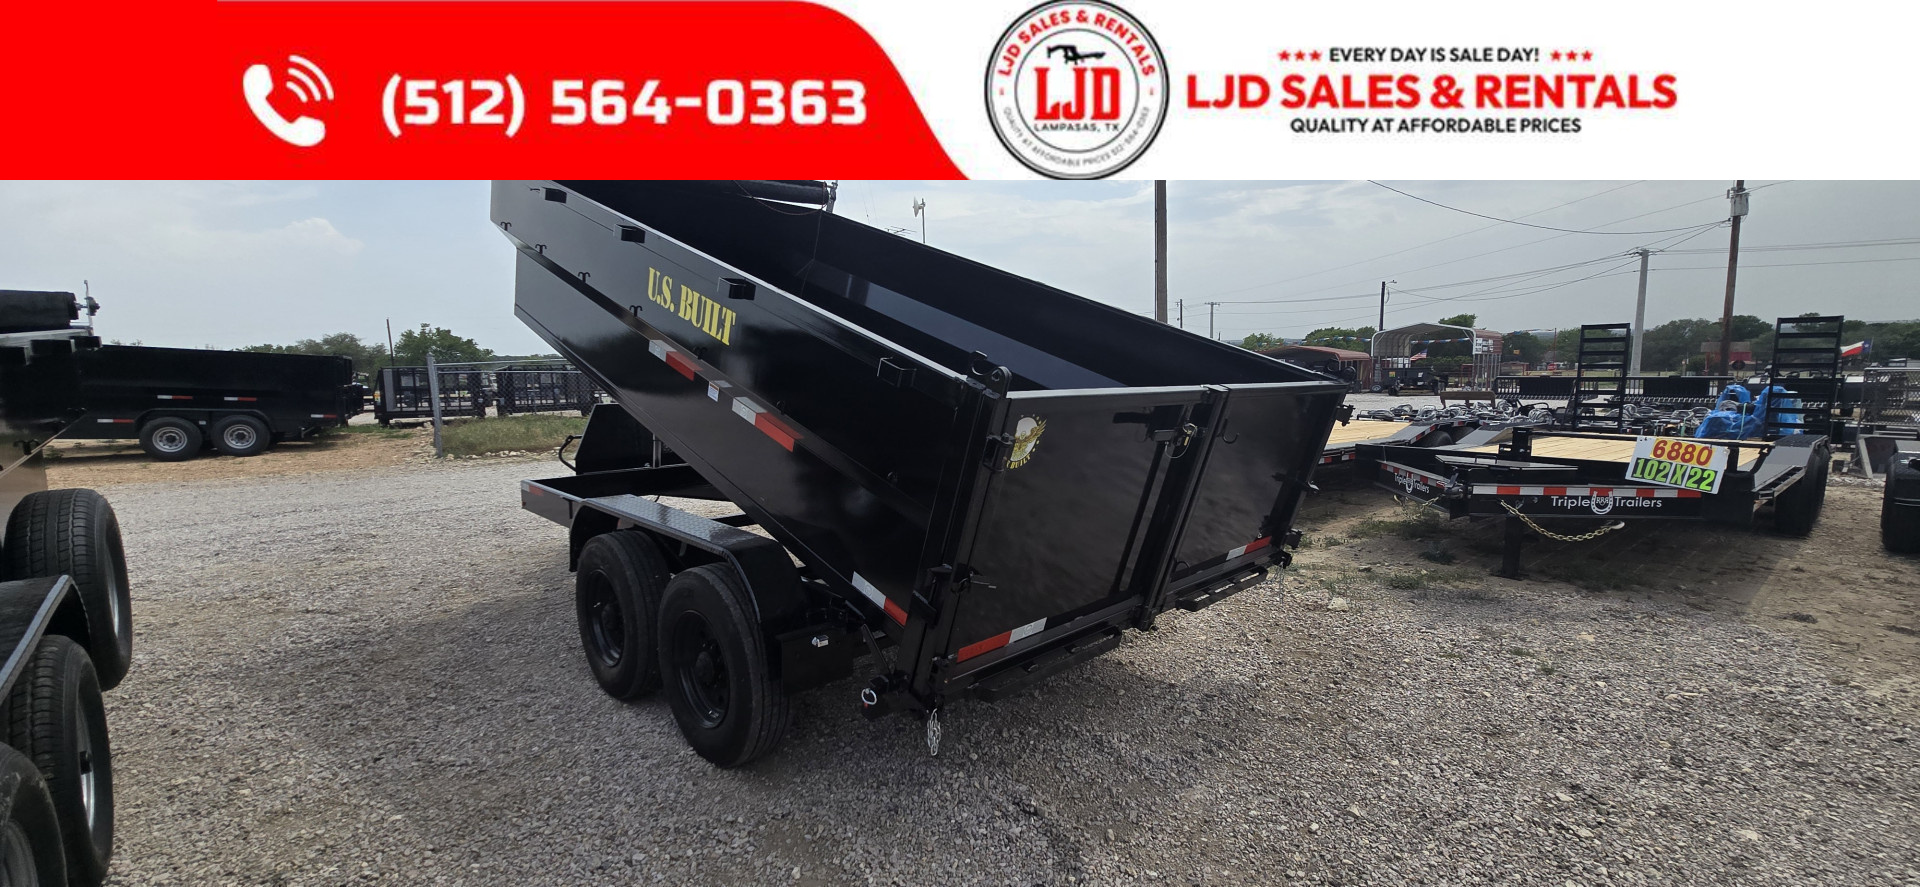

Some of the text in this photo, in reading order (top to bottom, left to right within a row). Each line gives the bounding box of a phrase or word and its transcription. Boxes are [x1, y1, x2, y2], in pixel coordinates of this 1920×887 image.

[647, 266, 737, 346] U.S. BUILT
[1652, 439, 1713, 467] 6880
[1551, 495, 1591, 509] Triple
[1614, 496, 1662, 508] Trailers
